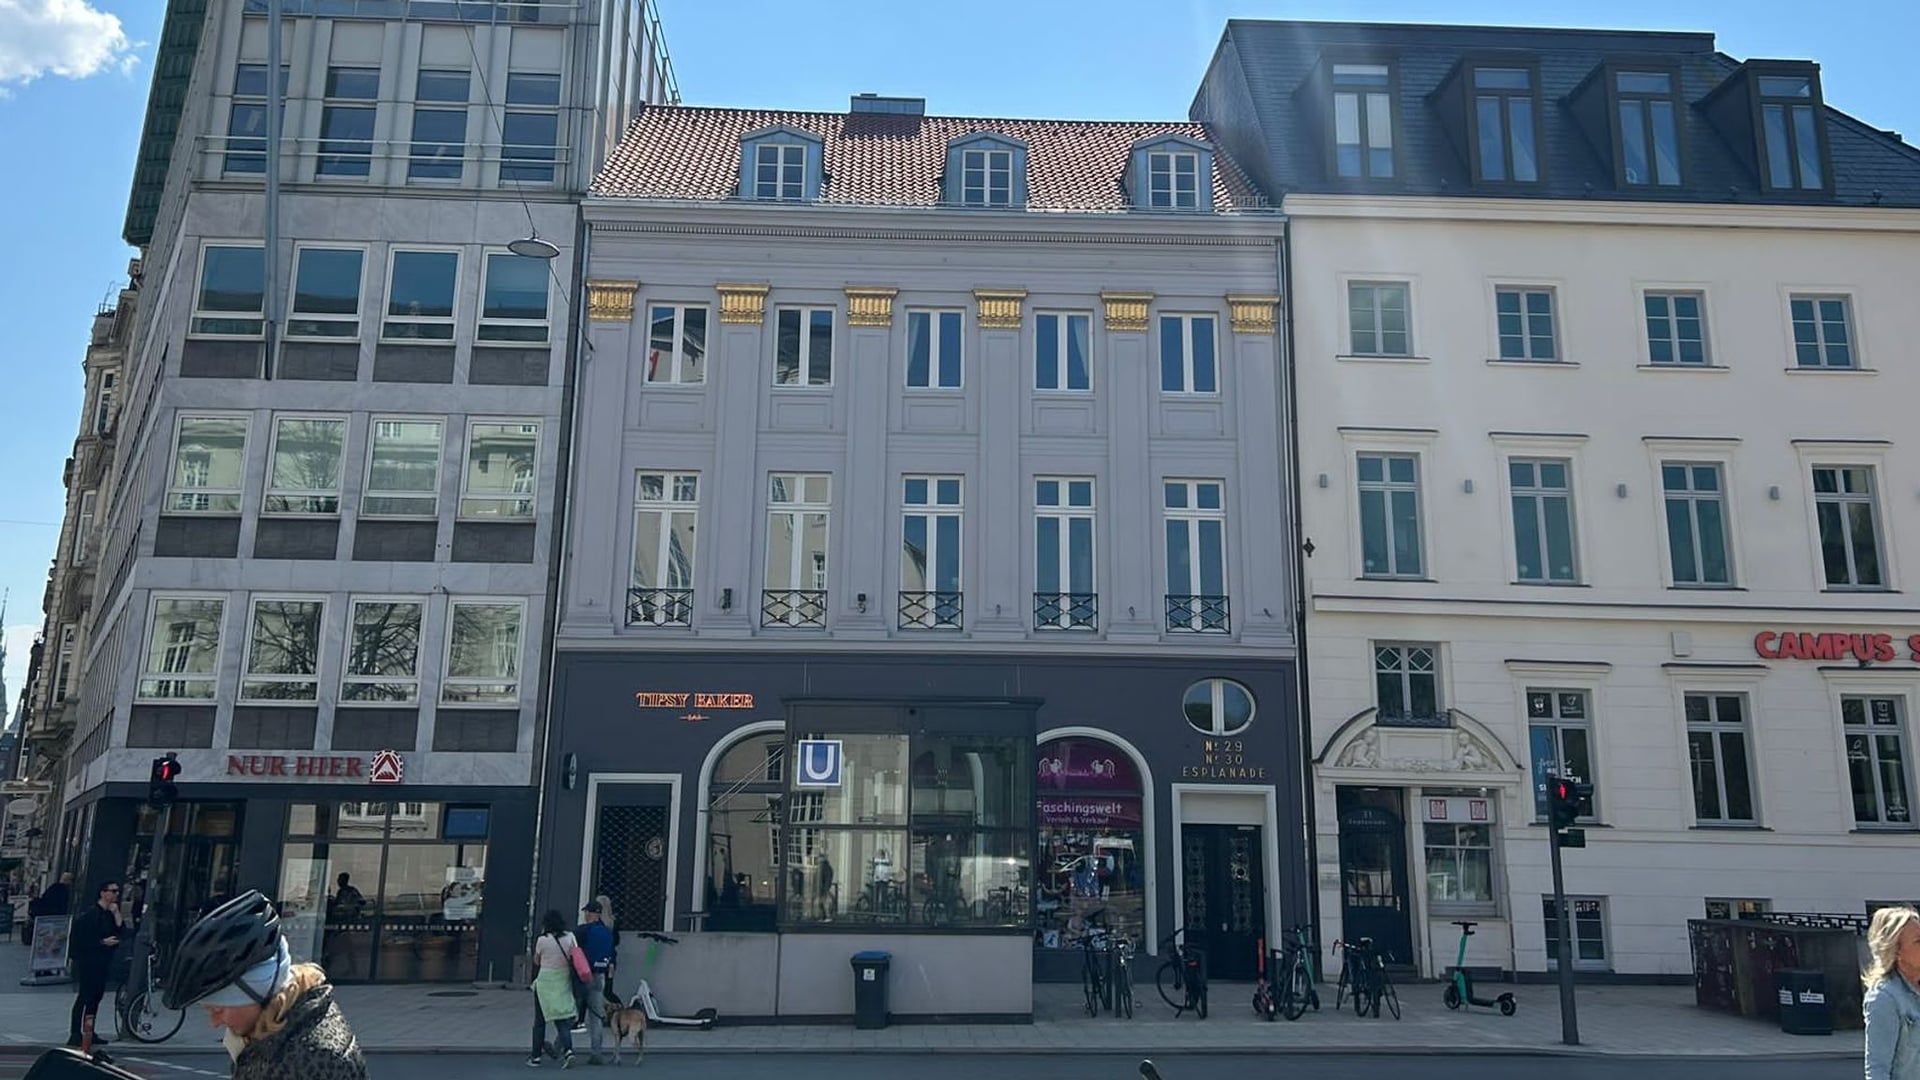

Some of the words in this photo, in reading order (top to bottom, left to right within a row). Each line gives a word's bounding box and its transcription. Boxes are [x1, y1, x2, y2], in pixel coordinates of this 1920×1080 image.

[1755, 631, 1896, 662] CAMPUS
[636, 692, 690, 708] TIPSY
[694, 693, 754, 708] BAKER
[1224, 740, 1242, 752] 29
[226, 755, 287, 776] NUR
[294, 756, 363, 777] HIER
[806, 744, 835, 780] U
[1225, 754, 1243, 765] 30
[1182, 766, 1266, 779] ESPLANADE
